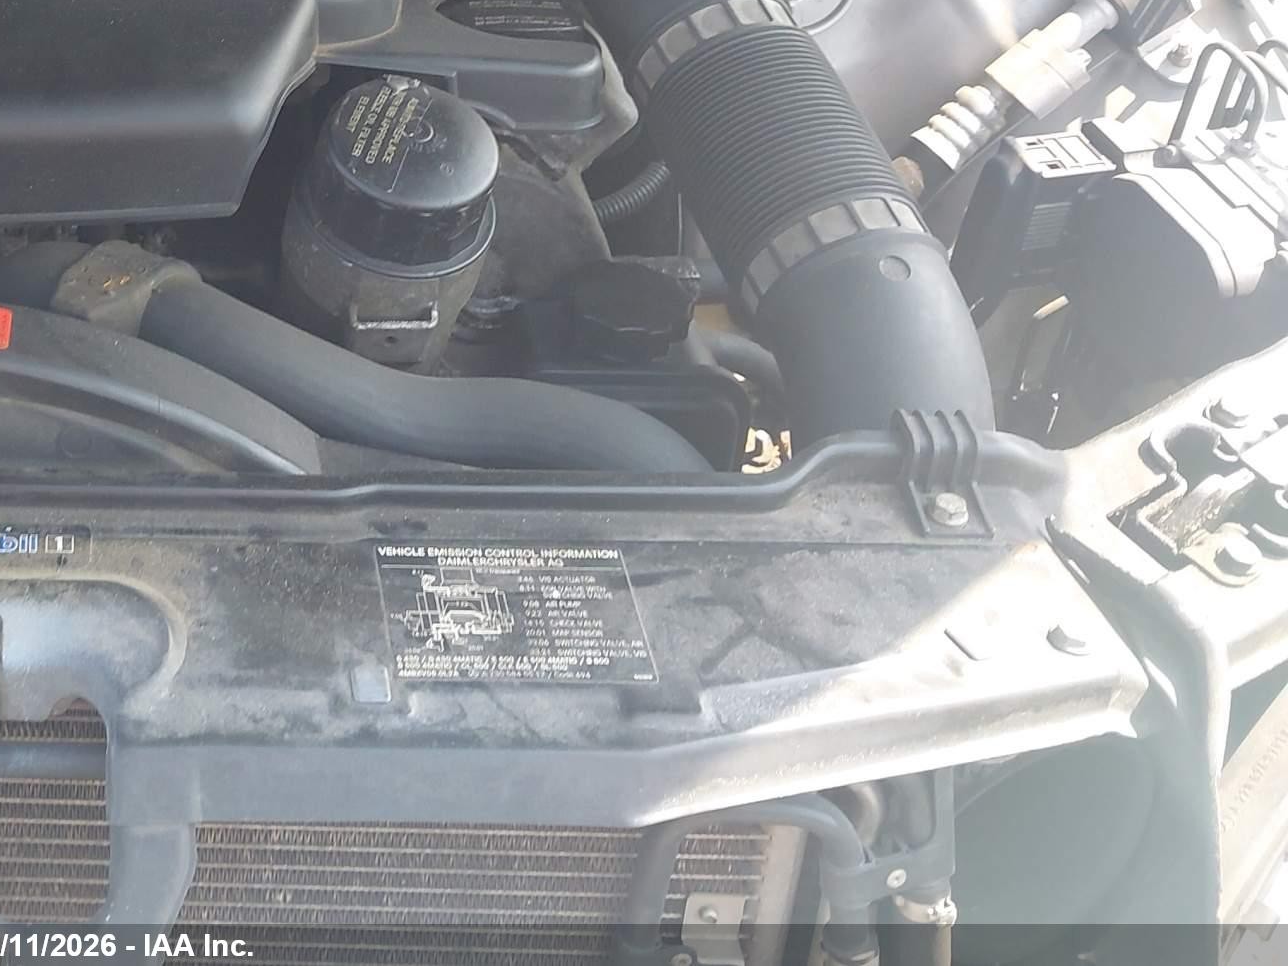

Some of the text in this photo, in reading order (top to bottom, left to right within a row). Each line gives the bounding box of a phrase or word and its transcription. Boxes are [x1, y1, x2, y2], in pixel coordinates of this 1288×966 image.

[377, 546, 619, 560] VEHICLE EMISSION CONTROL INFORMATION
[437, 556, 565, 567] DAIMLERCHRYSLER AG
[553, 575, 596, 584] ACTUATOR
